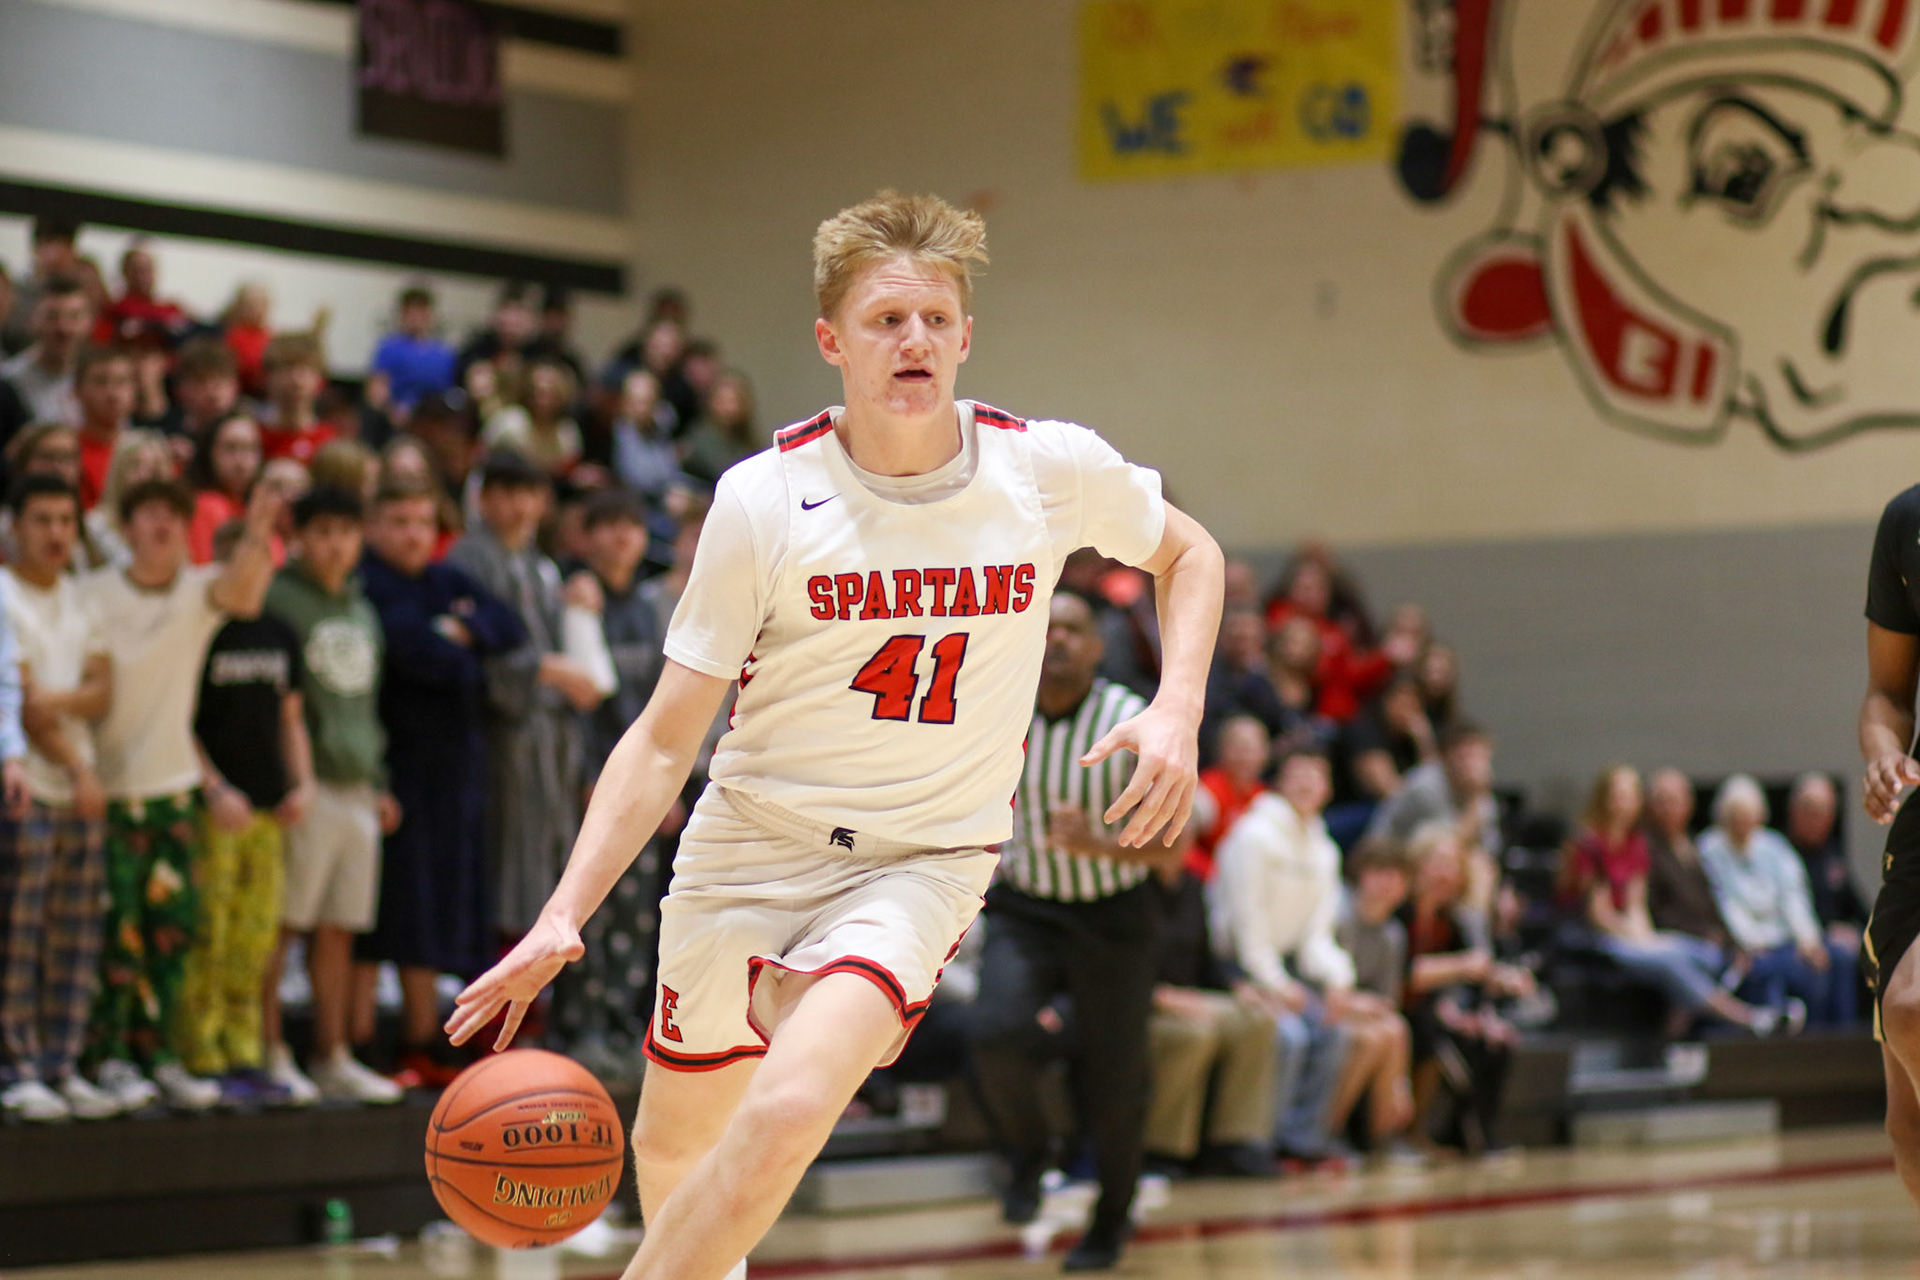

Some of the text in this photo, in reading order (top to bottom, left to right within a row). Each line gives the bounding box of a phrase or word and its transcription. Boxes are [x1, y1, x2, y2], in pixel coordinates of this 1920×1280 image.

[807, 563, 1036, 621] SPARTANS
[848, 632, 970, 725] 41
[661, 983, 683, 1043] E
